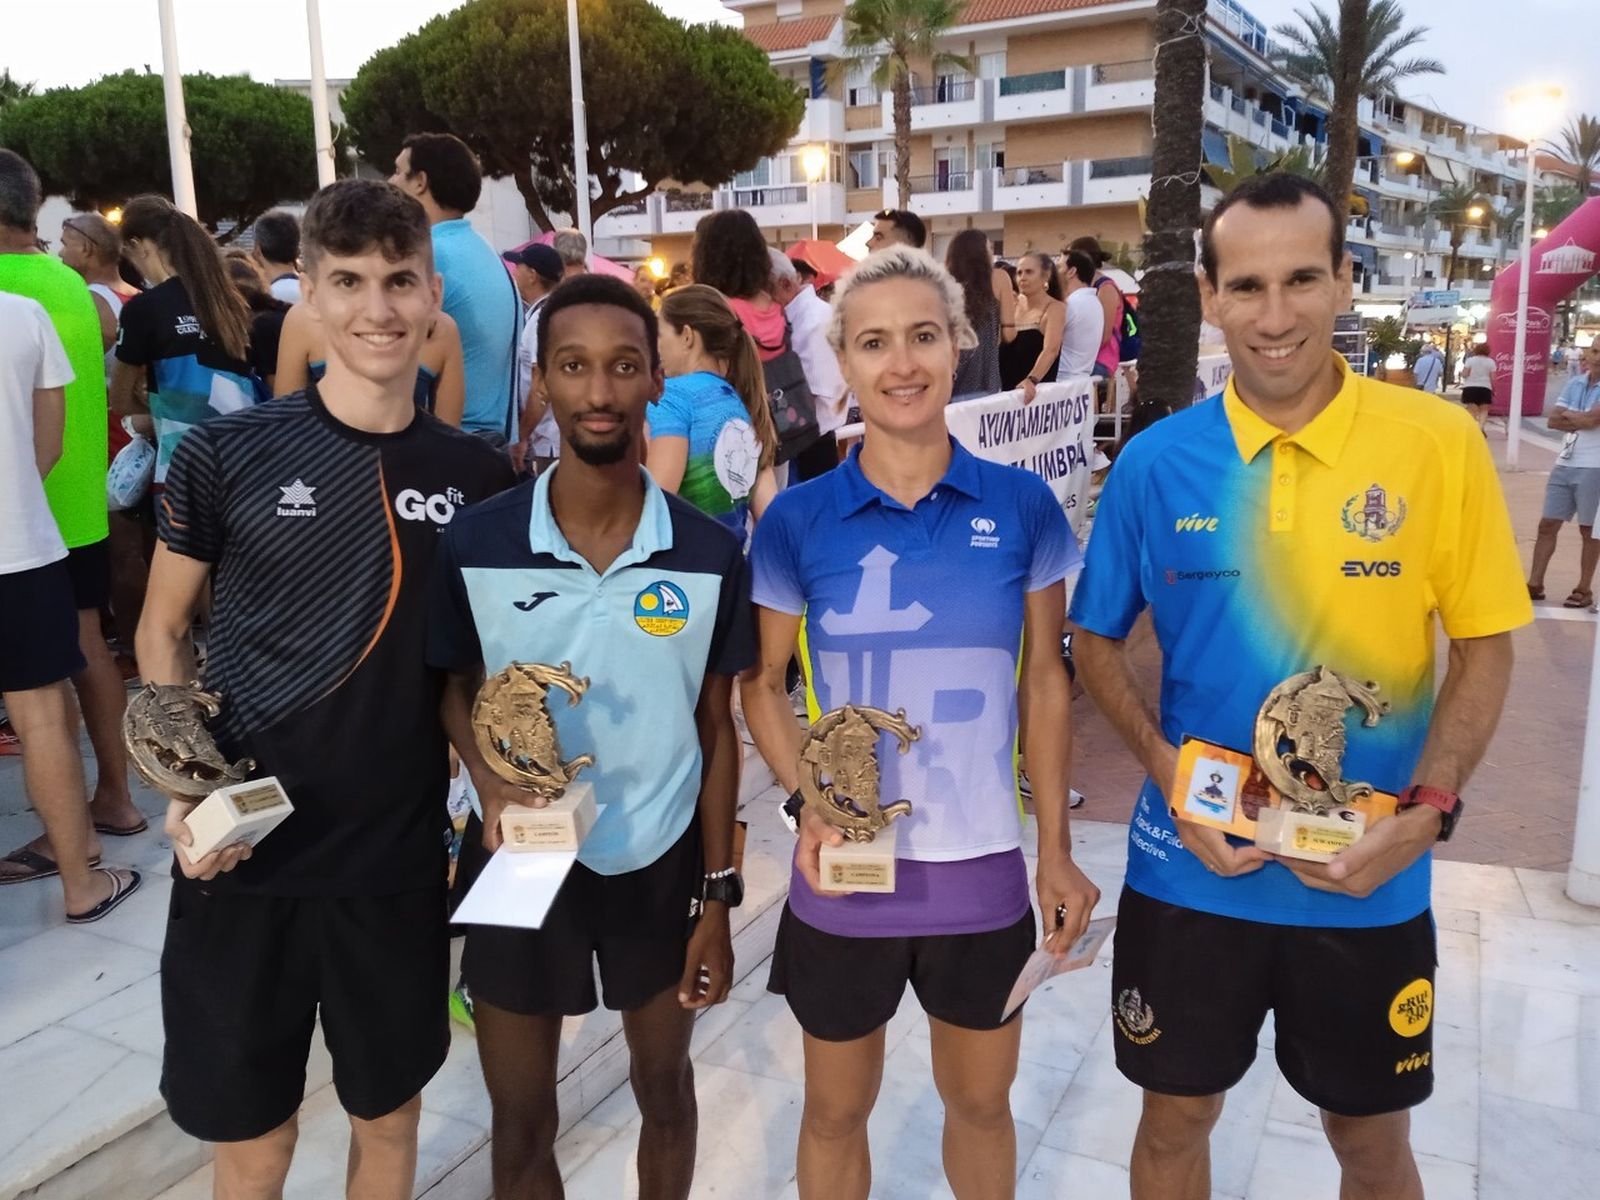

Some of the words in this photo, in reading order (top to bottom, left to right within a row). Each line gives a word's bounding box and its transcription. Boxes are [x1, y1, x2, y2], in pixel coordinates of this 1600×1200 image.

[979, 399, 1073, 449] AYUNTAMIENTO
[276, 506, 317, 517] luanvi
[395, 488, 455, 525] GO
[446, 486, 465, 505] fit
[1341, 561, 1402, 577] EVOS
